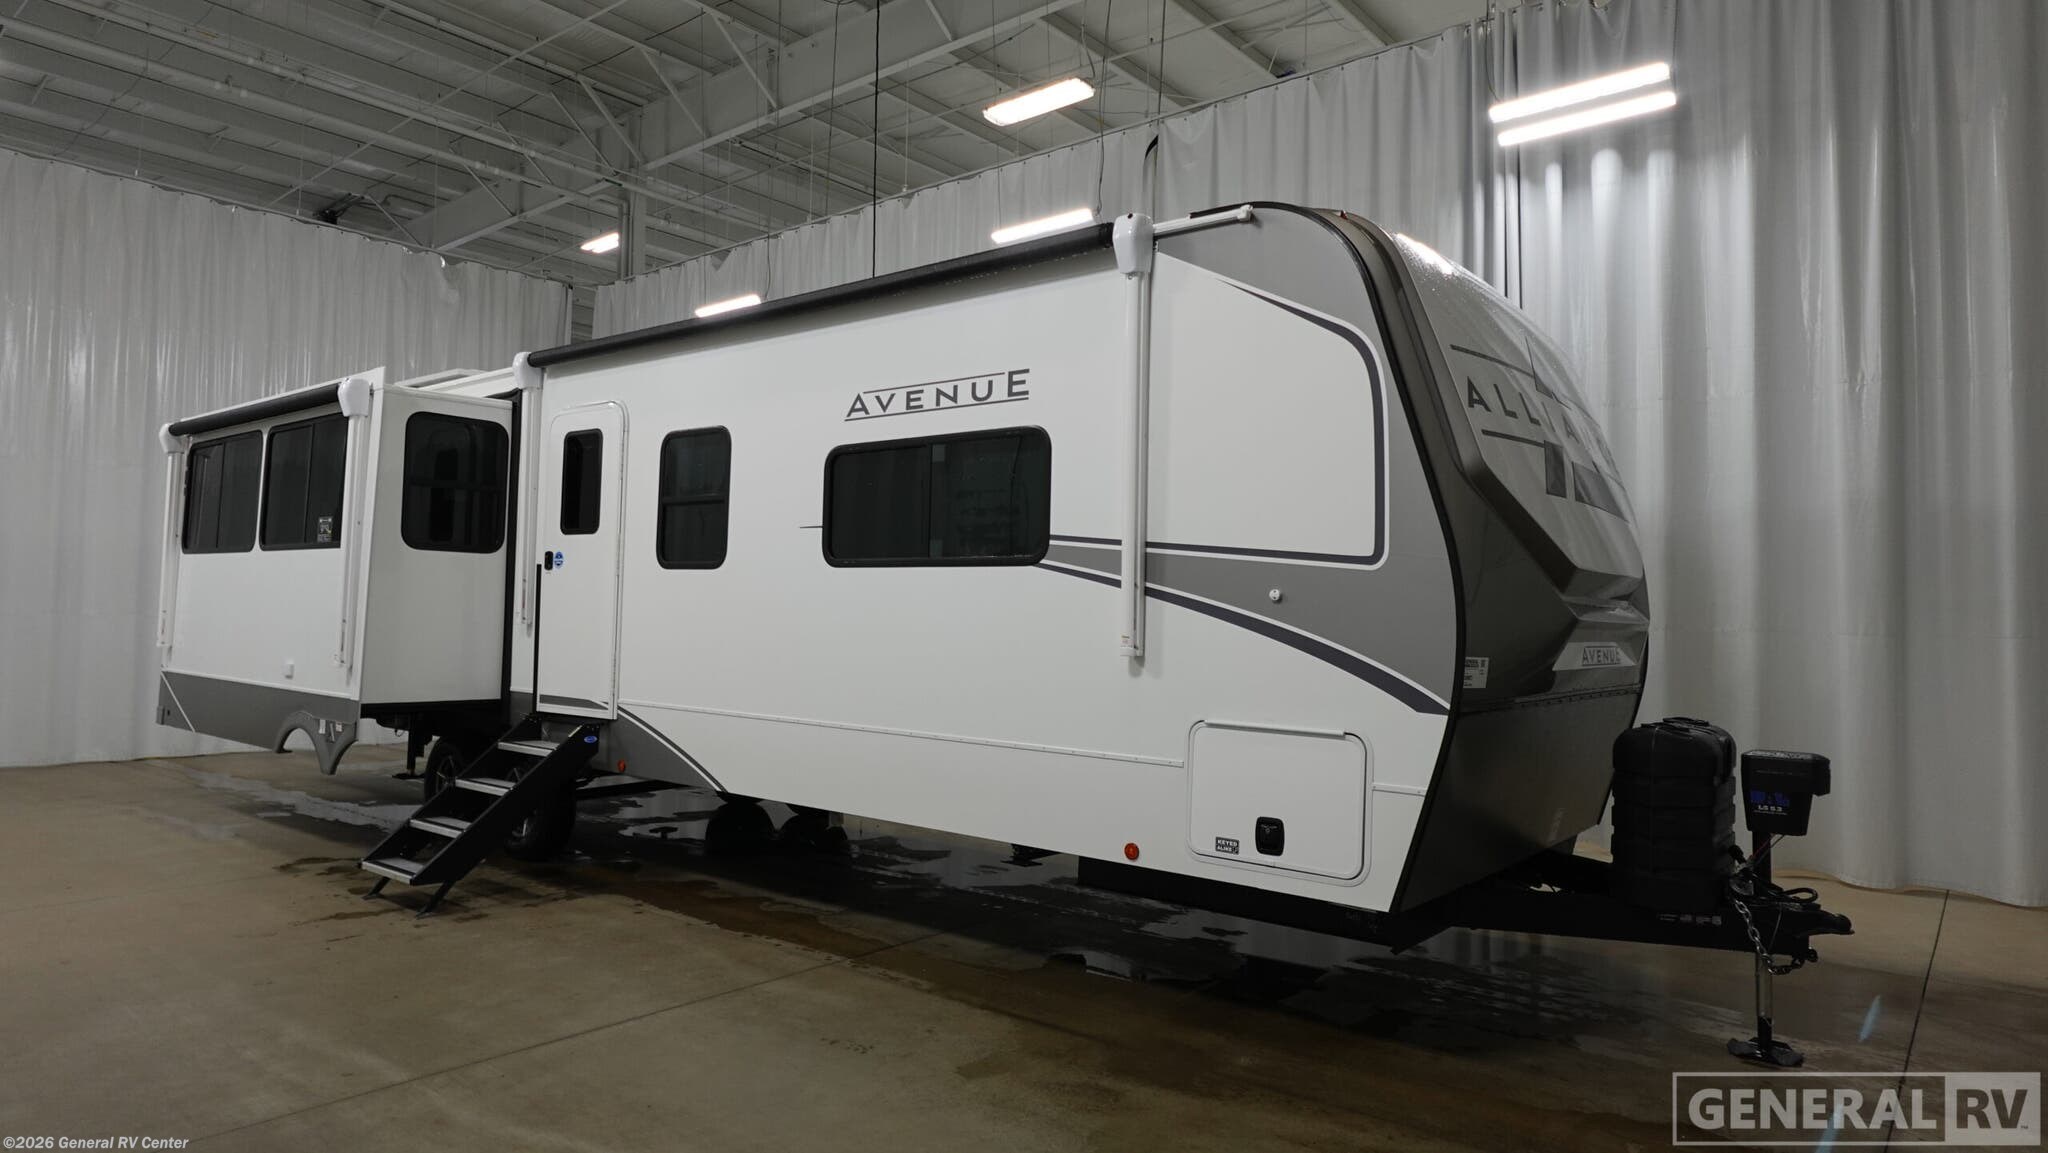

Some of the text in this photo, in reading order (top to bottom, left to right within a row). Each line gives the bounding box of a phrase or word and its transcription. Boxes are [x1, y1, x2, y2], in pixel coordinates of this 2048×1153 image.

[846, 368, 1030, 418] AVENUE
[1583, 647, 1621, 663] AVENUE
[1217, 839, 1237, 847] KEYED
